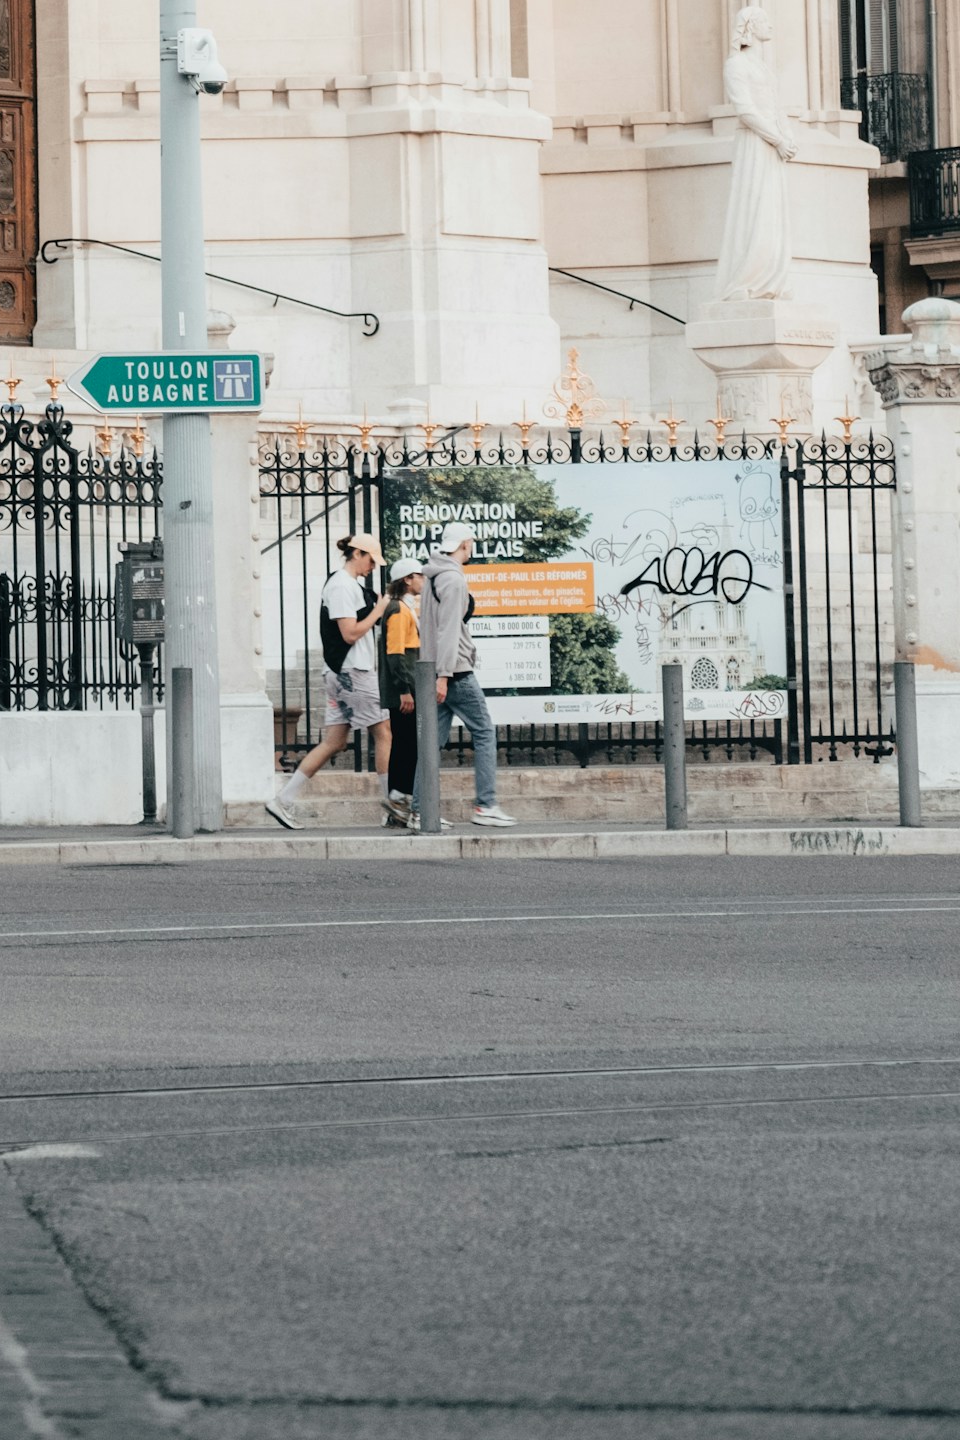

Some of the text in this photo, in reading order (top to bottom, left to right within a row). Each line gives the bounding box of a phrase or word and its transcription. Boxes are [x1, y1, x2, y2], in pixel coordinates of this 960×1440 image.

[124, 361, 209, 380] TOULON
[107, 383, 209, 403] AUBAGNE
[400, 500, 516, 522] RÉNOVATION
[400, 523, 427, 541] DU
[531, 571, 545, 581] LES
[472, 621, 541, 631] TOTAL 18 000 000 €
